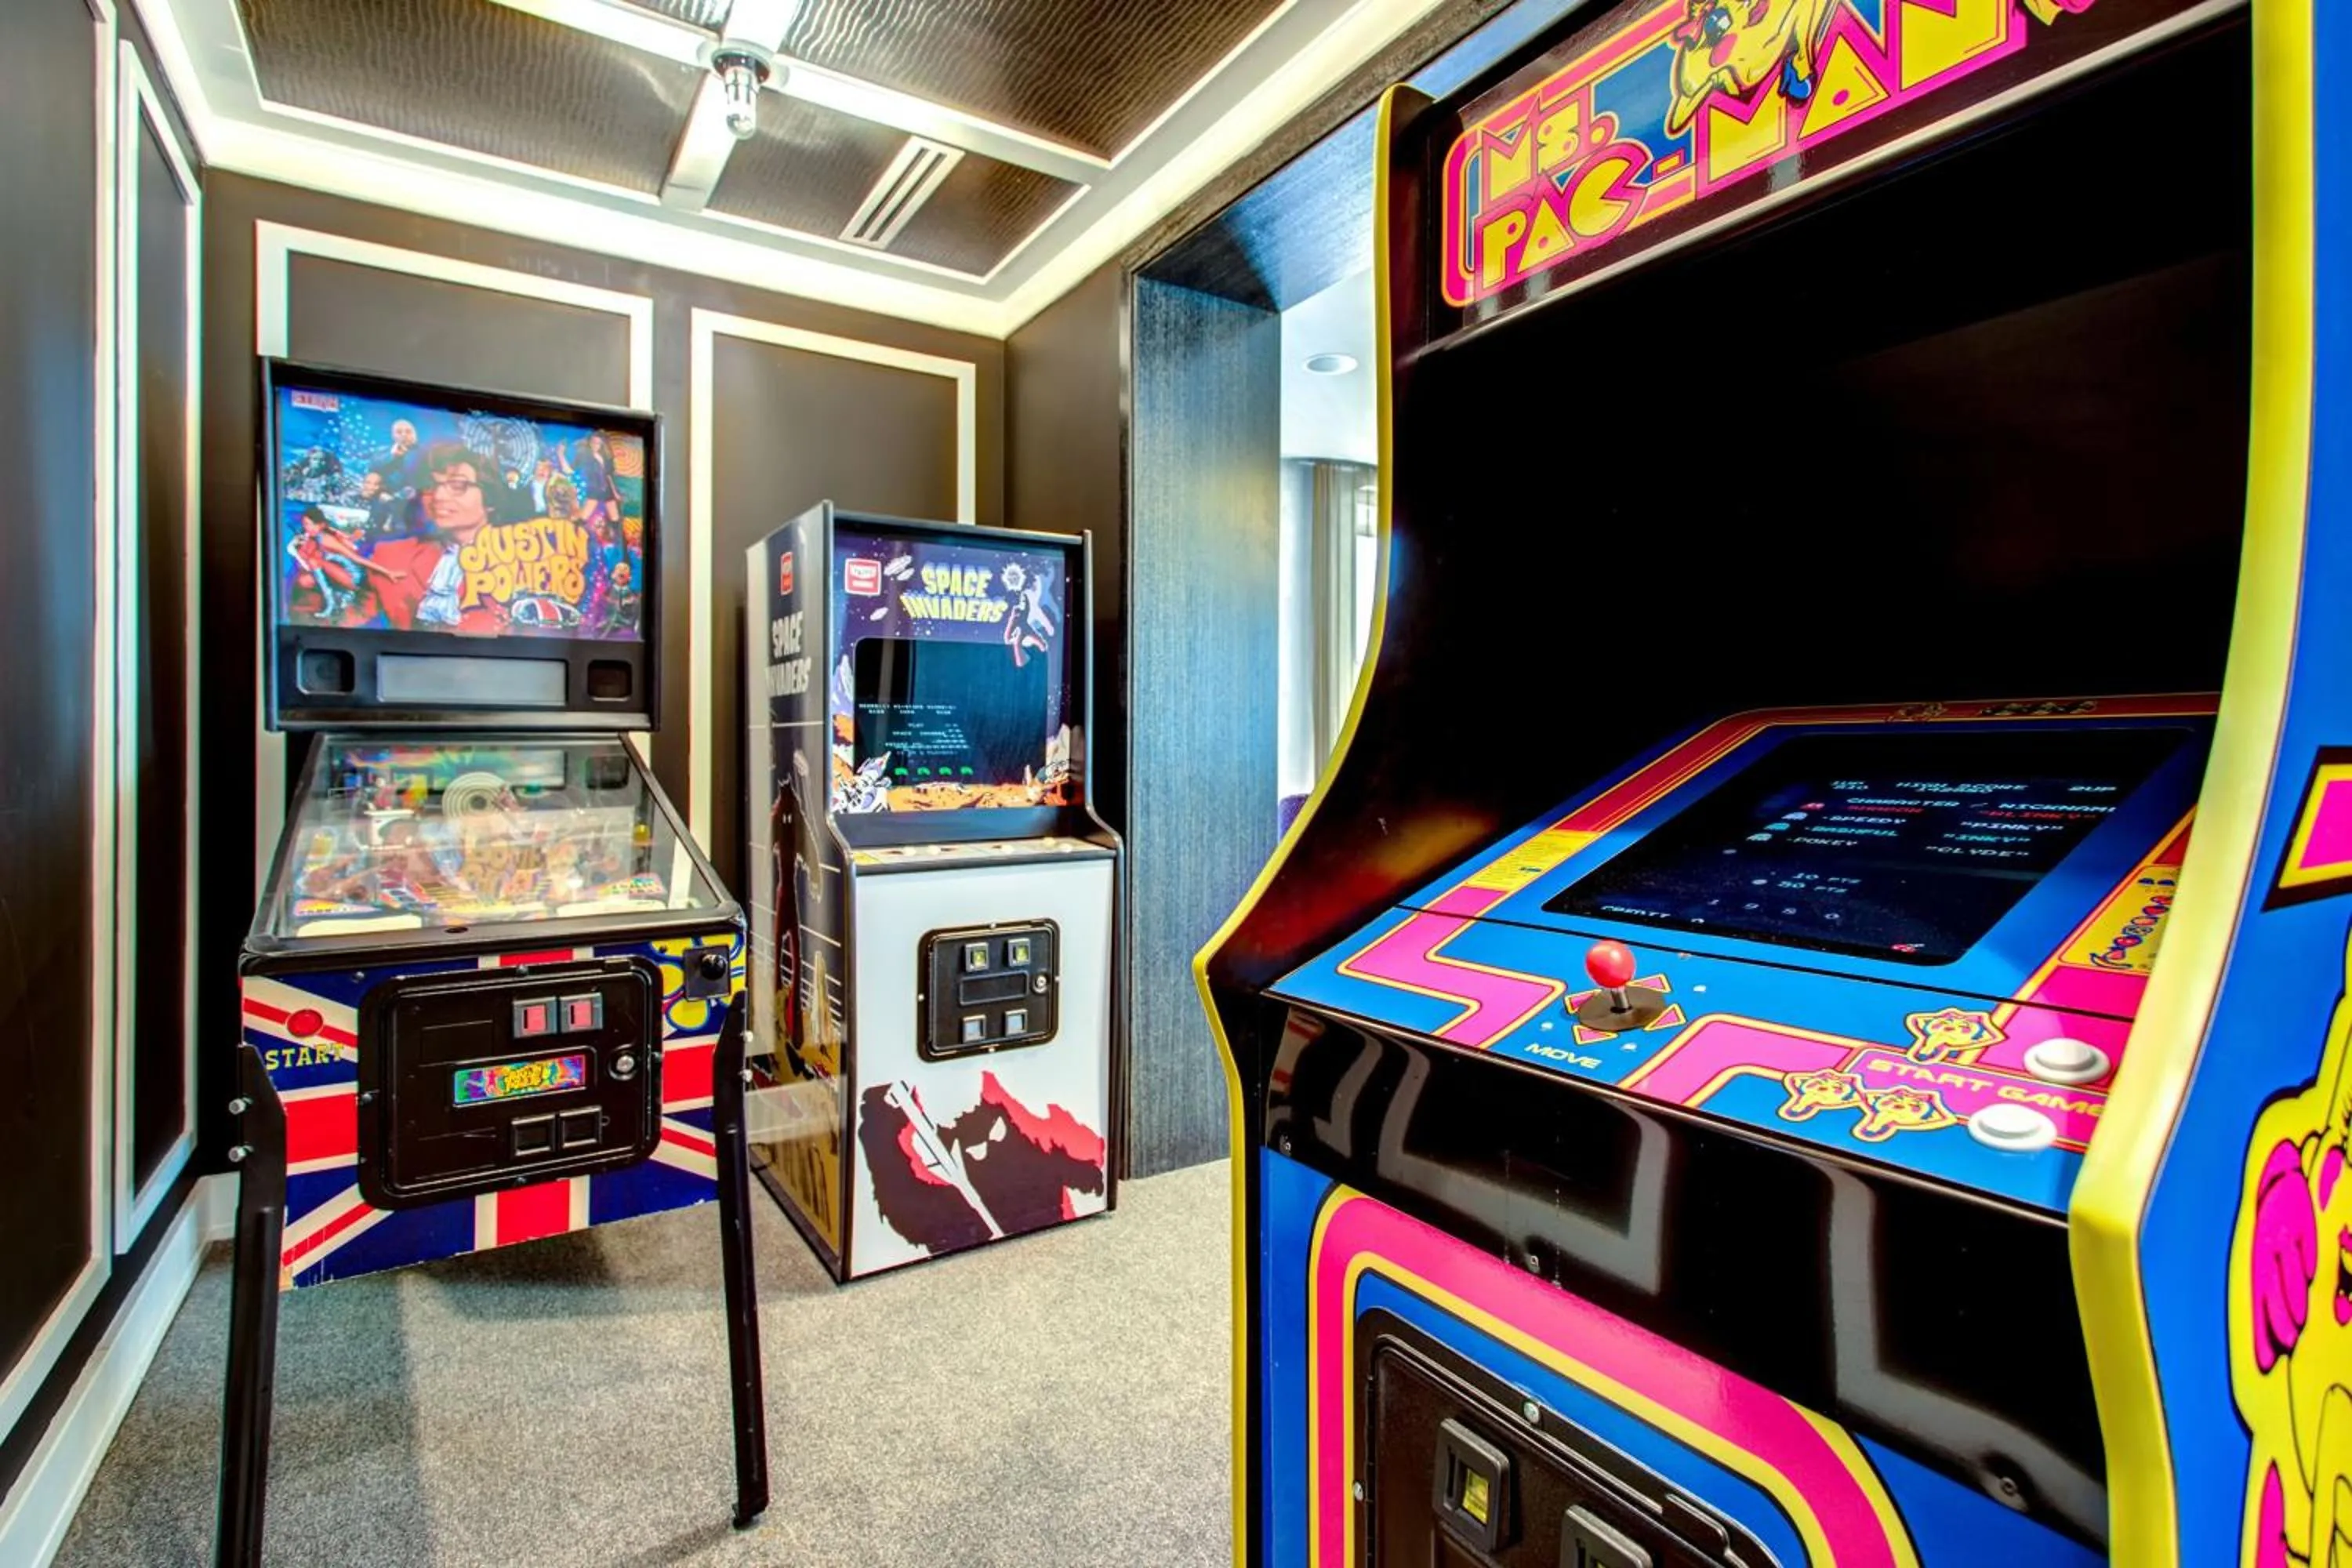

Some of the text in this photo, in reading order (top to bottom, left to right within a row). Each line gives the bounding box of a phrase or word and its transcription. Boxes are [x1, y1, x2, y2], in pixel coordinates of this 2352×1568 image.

[459, 517, 589, 572] AUSTIN
[459, 555, 585, 609] POWERS
[920, 562, 993, 599] SPACE
[900, 592, 1008, 623] INVADERS
[772, 611, 804, 659] SPACE
[264, 1041, 344, 1071] START
[1524, 1042, 1603, 1069] MOVE
[1866, 1058, 1994, 1092] START
